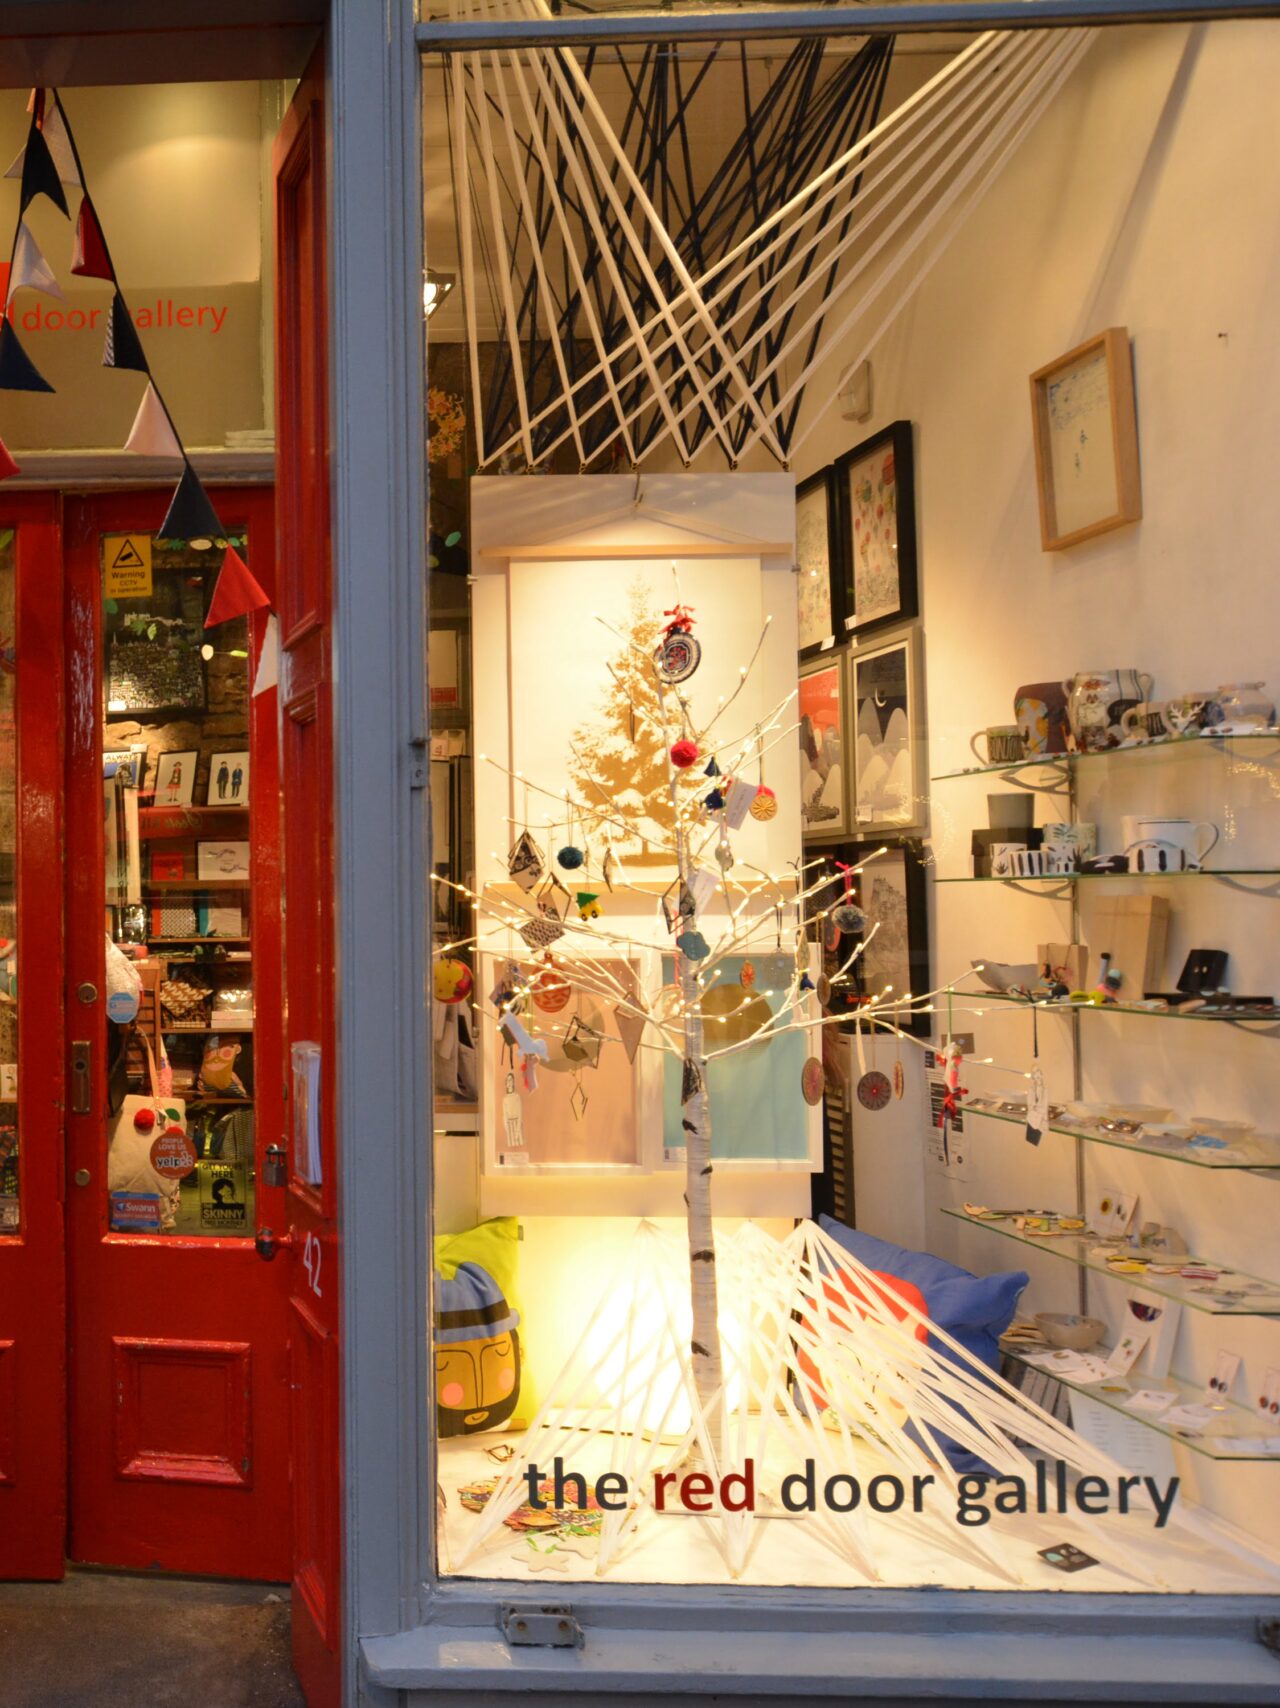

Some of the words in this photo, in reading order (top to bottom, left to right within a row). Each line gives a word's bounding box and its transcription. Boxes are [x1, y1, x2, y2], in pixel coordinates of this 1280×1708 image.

[22, 304, 100, 332] door
[128, 299, 228, 334] allery
[112, 571, 145, 579] Warning
[156, 1156, 181, 1168] yelp
[211, 1170, 233, 1178] HERE
[125, 1202, 155, 1212] Swann
[203, 1209, 243, 1219] SKINNY
[523, 1457, 629, 1513] the
[654, 1457, 756, 1513] red
[780, 1457, 936, 1514] door
[956, 1459, 1182, 1528] gallery
